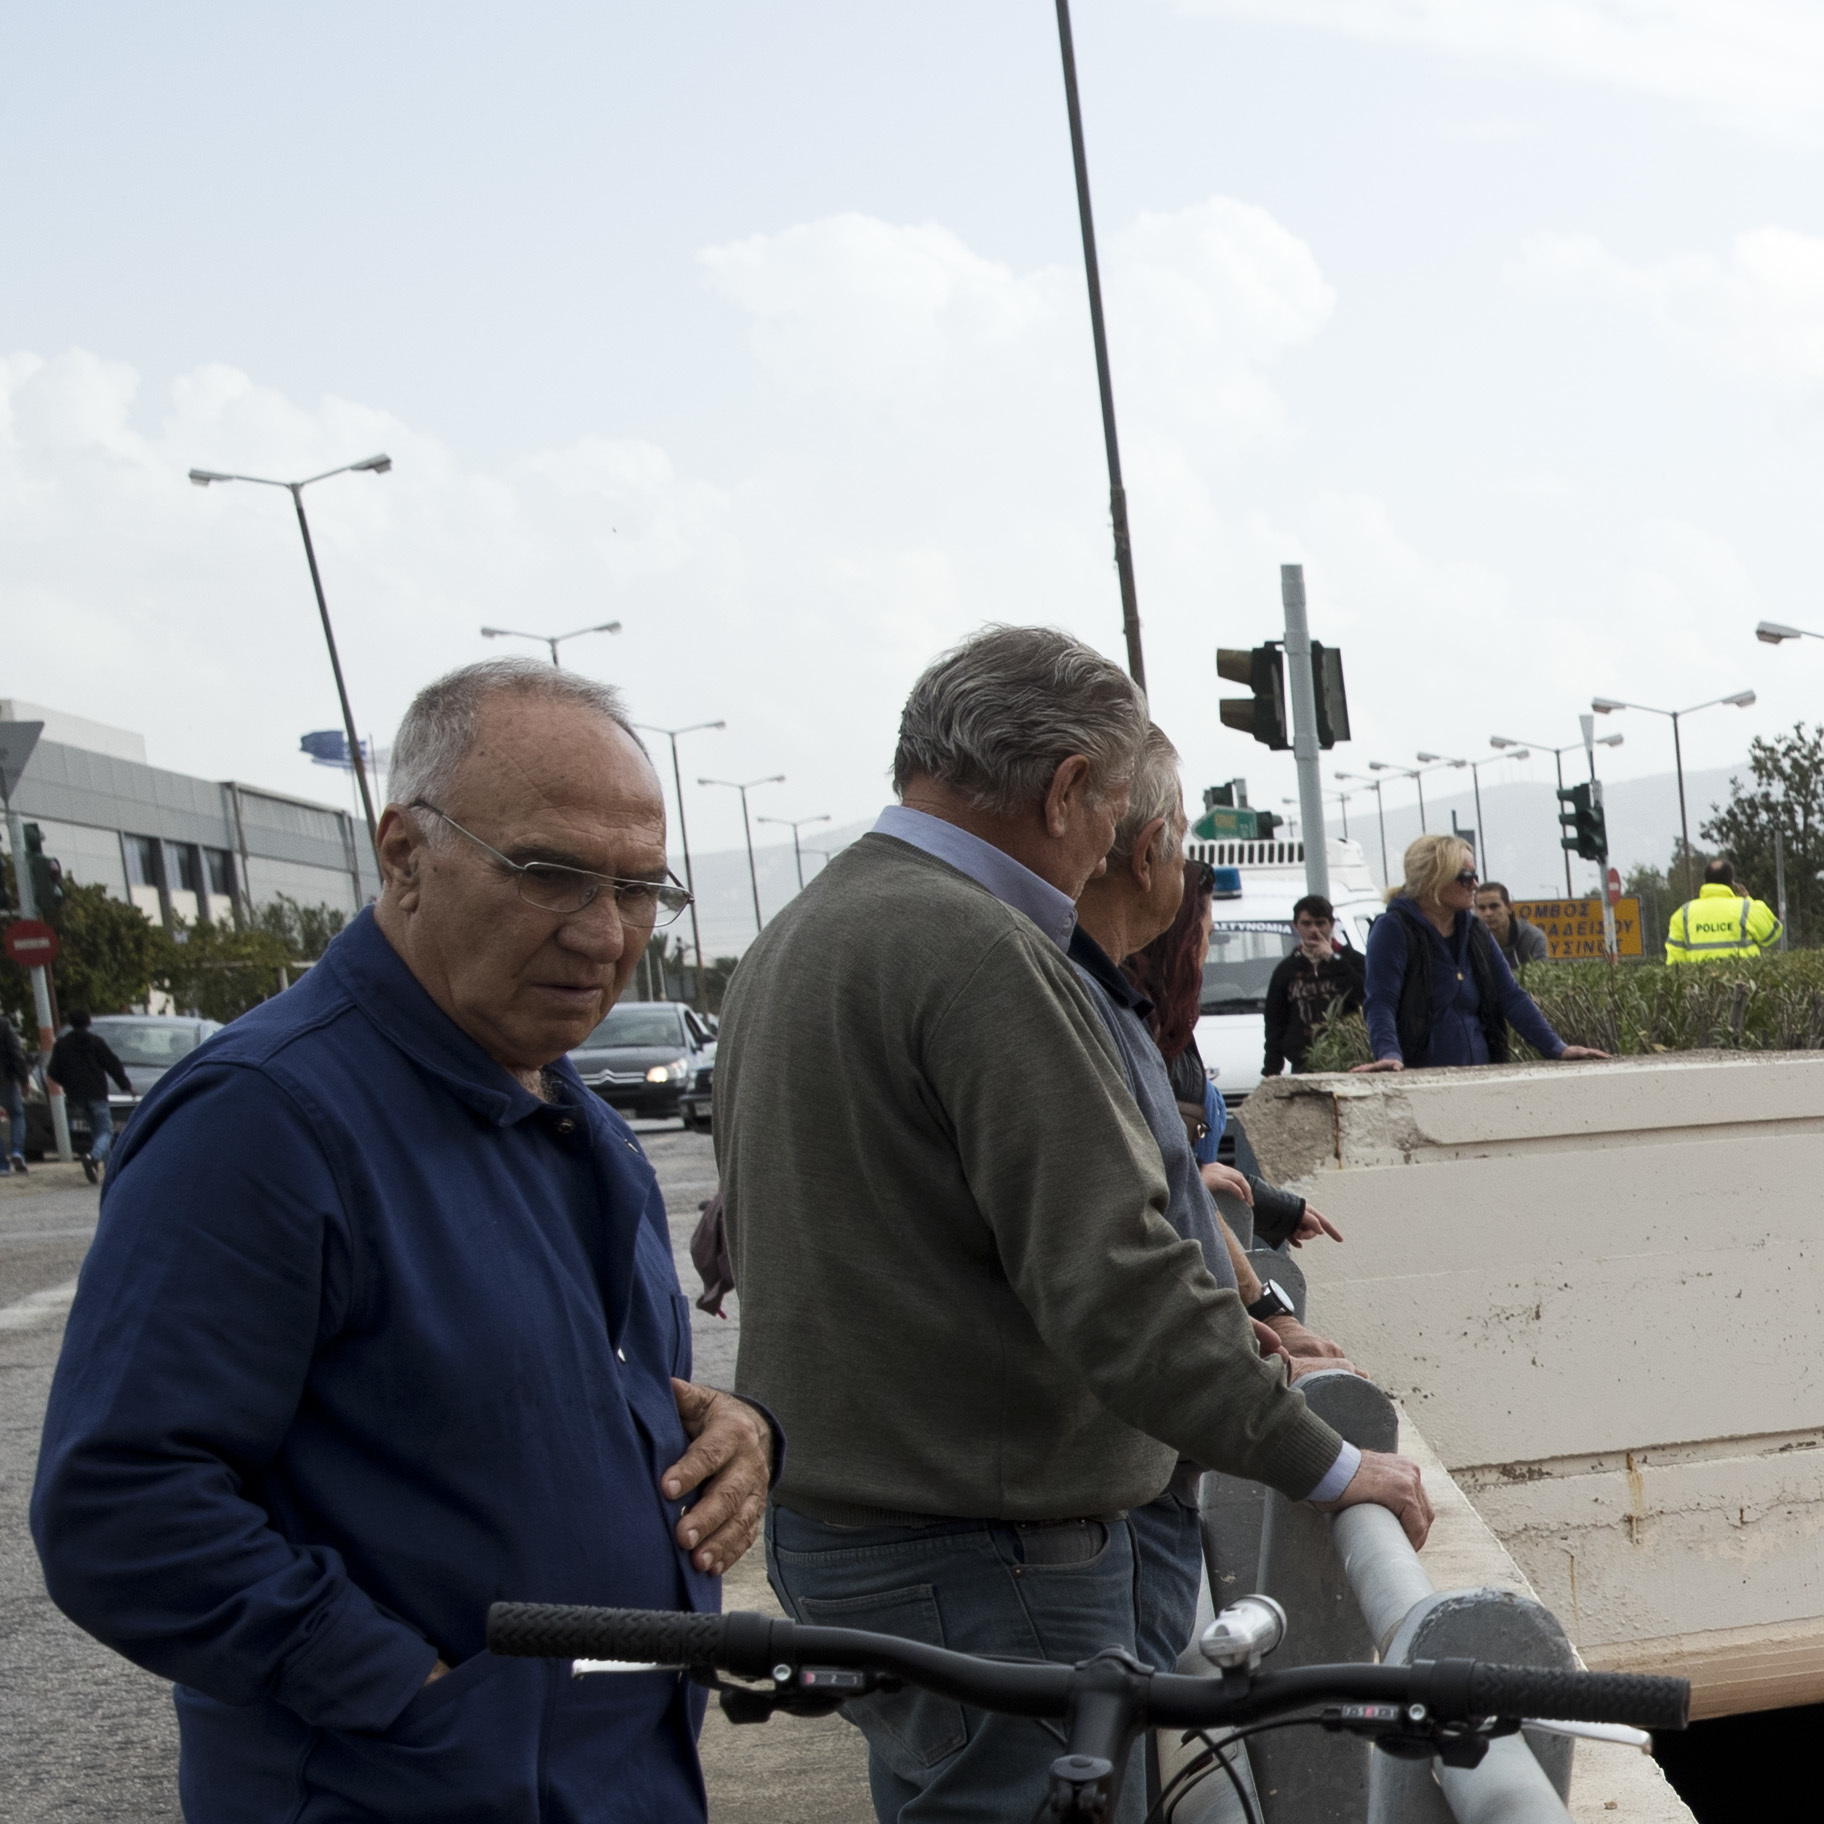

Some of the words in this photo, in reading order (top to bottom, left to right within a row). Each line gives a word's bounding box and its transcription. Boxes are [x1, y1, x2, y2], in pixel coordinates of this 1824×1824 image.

[1518, 902, 1591, 920] ΟΜΒΟΣ
[1696, 921, 1734, 934] POLICE
[830, 1674, 838, 1684] 2
